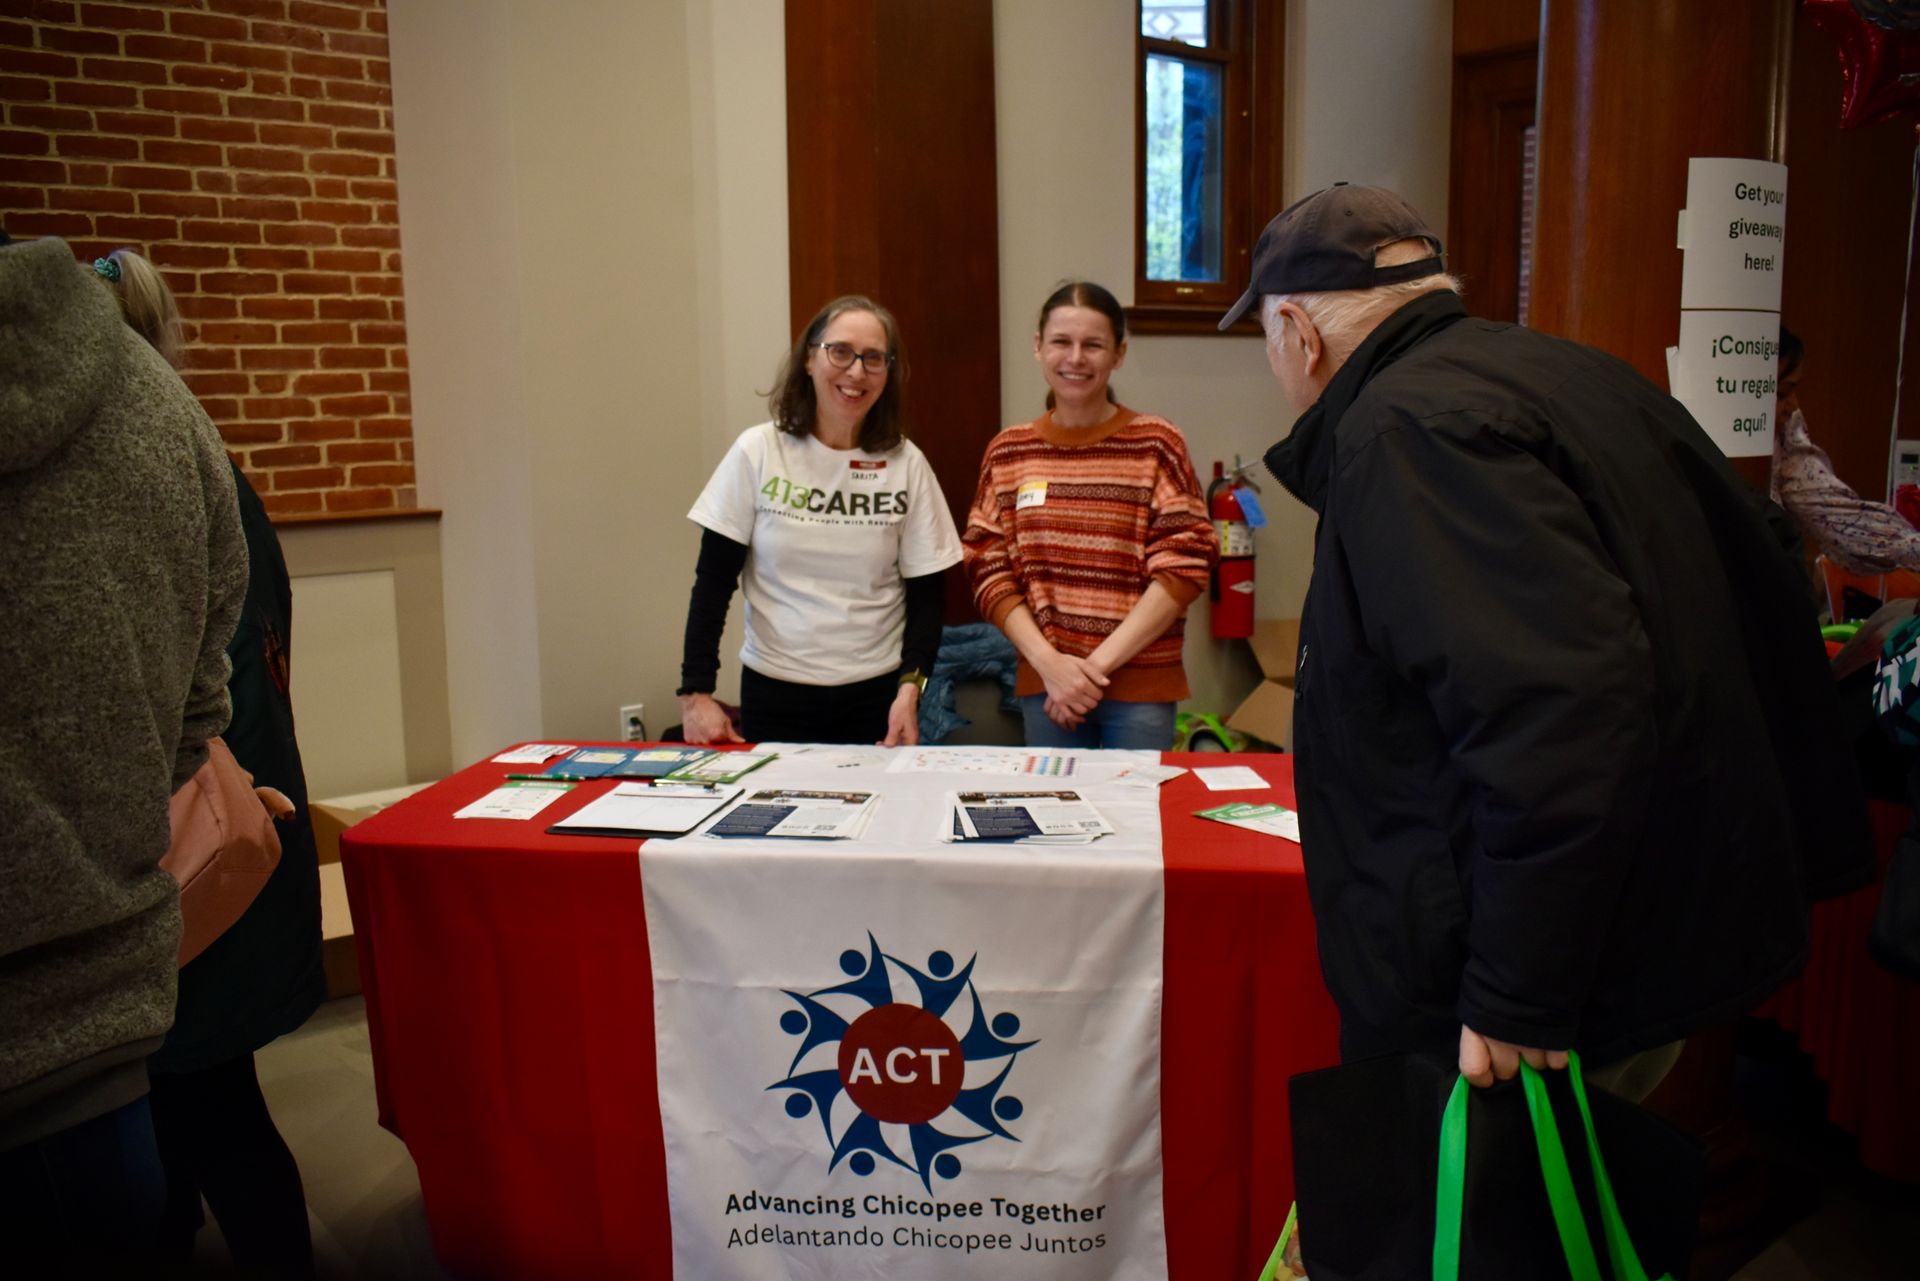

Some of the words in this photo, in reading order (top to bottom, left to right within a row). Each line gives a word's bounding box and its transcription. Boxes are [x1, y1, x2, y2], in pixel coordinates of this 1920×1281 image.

[1735, 182, 1762, 202] Get
[1763, 188, 1784, 206] your
[1728, 217, 1783, 243] giveaway
[1744, 252, 1775, 271] here!
[1716, 376, 1737, 394] tu
[1742, 374, 1776, 399] regalo
[761, 476, 908, 516] 413CARES
[848, 1047, 950, 1086] ACT
[725, 1190, 856, 1218] Advancing
[863, 1195, 983, 1222] Chicopee
[990, 1198, 1106, 1225] Together
[727, 1223, 884, 1249] Adelantando
[893, 1226, 1012, 1254] Chicopee
[1020, 1232, 1106, 1254] Juntos
